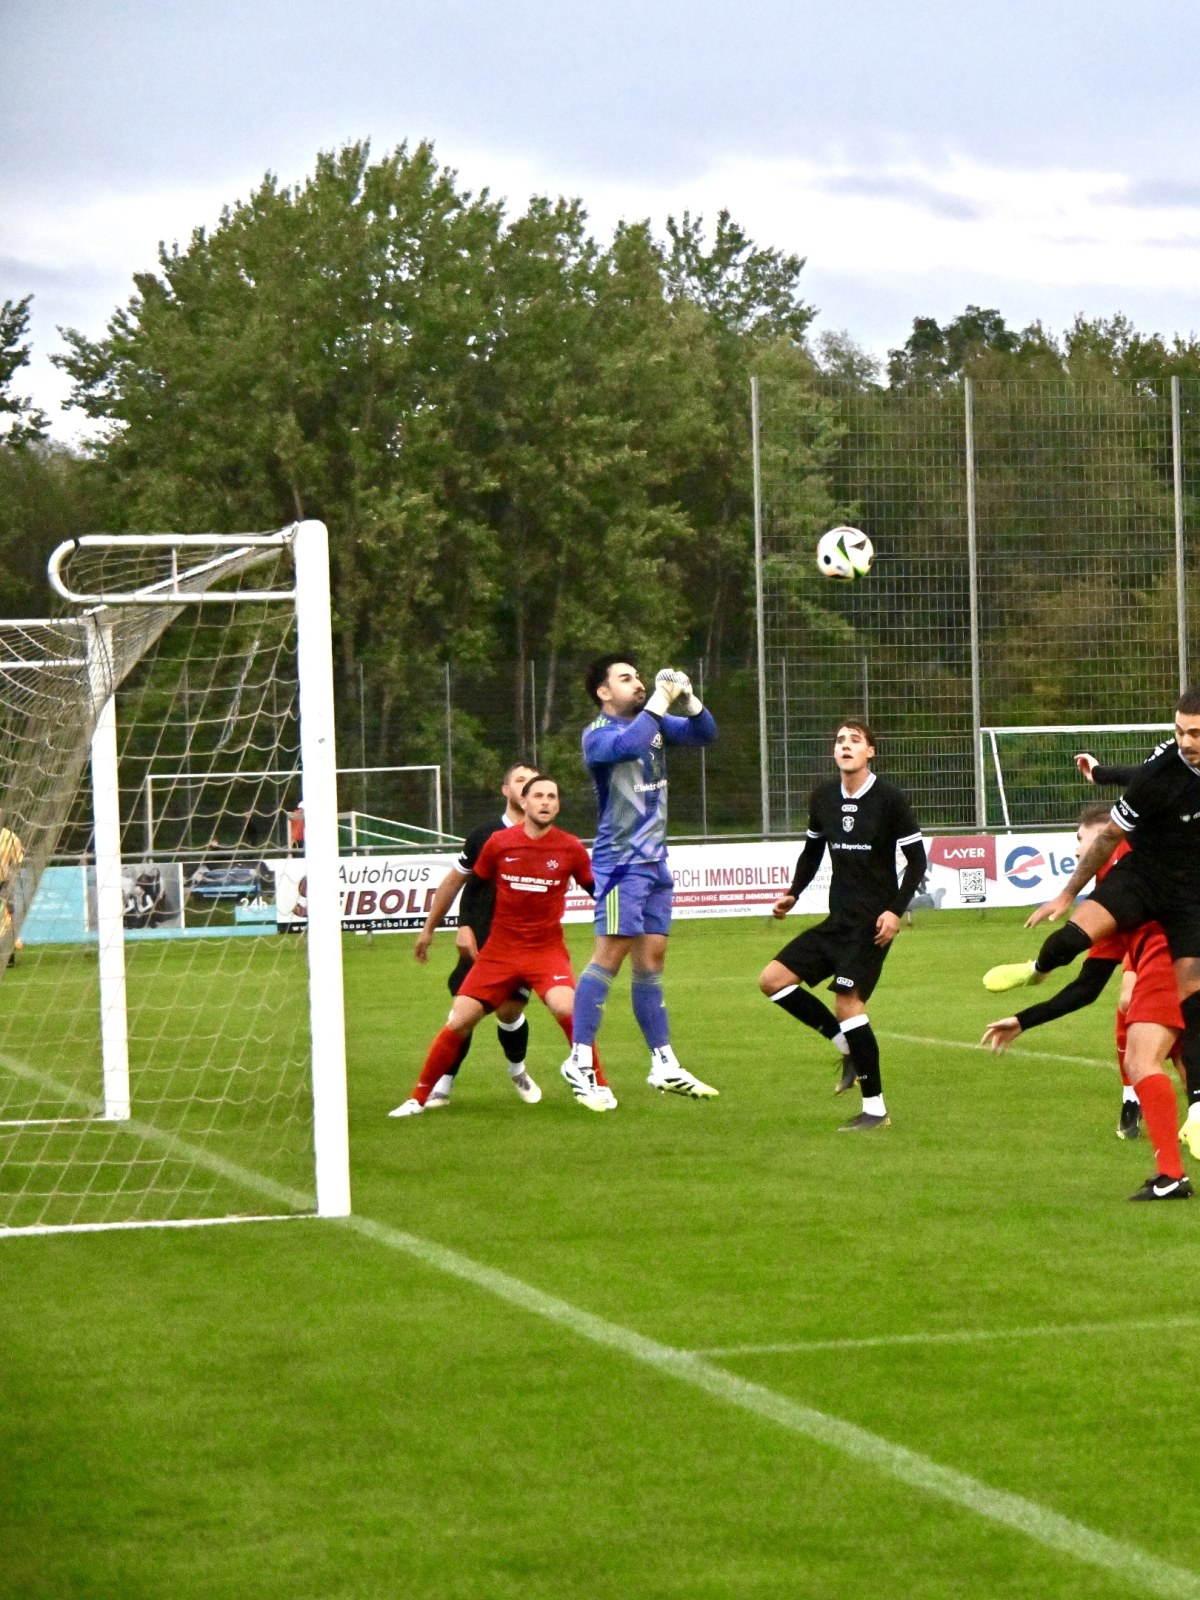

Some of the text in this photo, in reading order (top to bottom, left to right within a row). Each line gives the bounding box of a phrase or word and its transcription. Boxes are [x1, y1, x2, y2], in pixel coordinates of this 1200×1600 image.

[944, 847, 985, 859] LAYER
[339, 862, 431, 884] Autohaus
[241, 897, 268, 911] 24h
